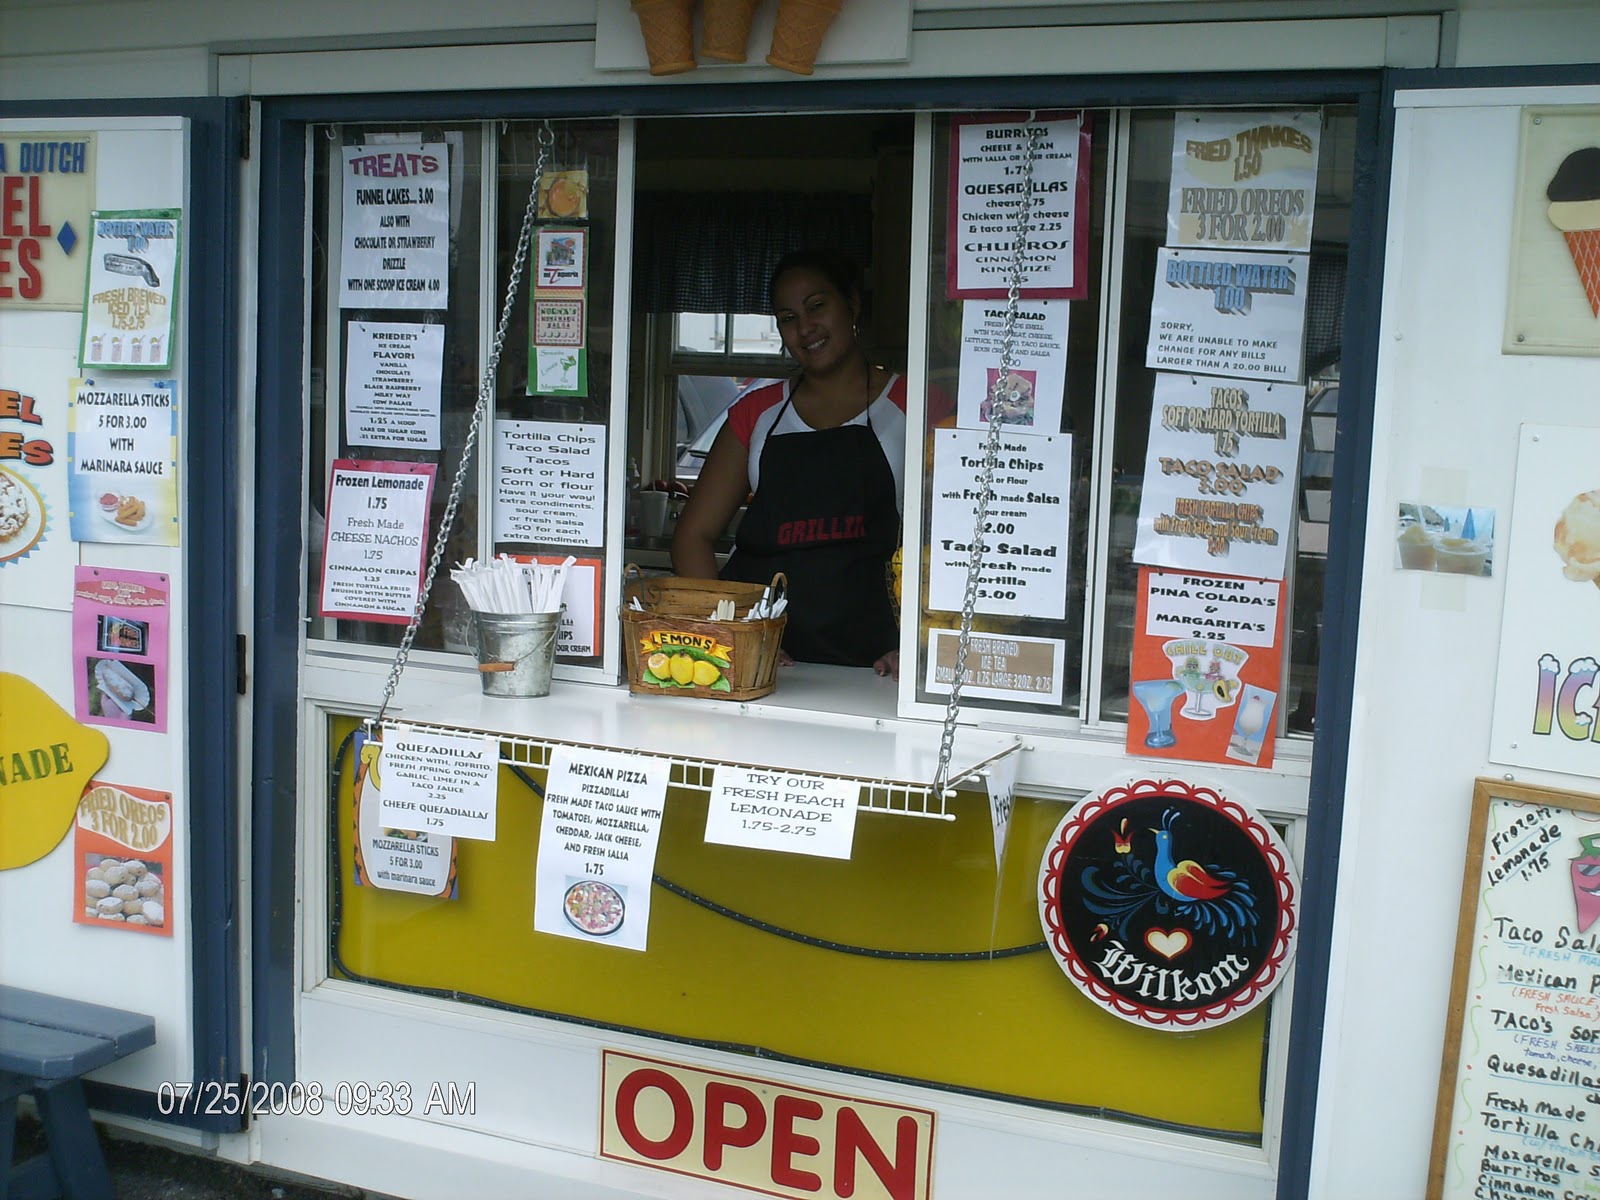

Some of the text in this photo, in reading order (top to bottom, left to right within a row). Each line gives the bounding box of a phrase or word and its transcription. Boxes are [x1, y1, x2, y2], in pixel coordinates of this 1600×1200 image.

[19, 141, 86, 173] DUTCH
[1186, 138, 1232, 162] FRIED
[349, 153, 439, 177] TREATS
[356, 189, 385, 205] FUNNEL
[418, 188, 434, 204] 3.00
[964, 181, 1068, 195] QUESADLLAS
[1181, 187, 1304, 216] FRIED OREOS
[380, 216, 410, 227] ALSO WITH
[1196, 213, 1286, 242] 3 FOR 2.00
[354, 238, 387, 249] CHOCOLATE
[397, 237, 436, 249] STRAWBERRY
[382, 258, 406, 270] DRIZZLE
[1166, 259, 1294, 293] BOTTLED WATER
[1214, 286, 1249, 312] 1.00
[1160, 321, 1194, 332] SORRY,
[372, 332, 418, 341] KRIEDER'S
[1159, 333, 1278, 349] WE ARE UNABLE TO MAKE
[373, 351, 415, 360] FLAVORS
[1158, 344, 1266, 360] CHANGE FOR ANY BILLS
[1156, 356, 1192, 366] LARGER
[1195, 359, 1220, 368] THAN
[1223, 361, 1230, 369] A
[1232, 363, 1260, 371] 20.00
[76, 392, 170, 408] MOZZARELLA STICKS
[1211, 387, 1247, 410] TACOS
[105, 415, 125, 428] FOR
[125, 416, 147, 429] 3.00
[1161, 405, 1285, 437] SOFT OR HARD TORTILLA
[109, 437, 134, 451] WITH
[501, 431, 596, 445] Tortilla Chips
[506, 443, 591, 455] Taco Salad
[80, 459, 163, 475] MARINARA SAUCE
[525, 455, 570, 466] Tacos
[1008, 458, 1044, 473] Chips
[501, 466, 534, 475] Soft
[560, 469, 595, 480] Hard
[1158, 457, 1284, 484] TACO SALAD
[335, 474, 424, 490] Frozen Lemonade
[501, 477, 534, 487] Corn
[560, 481, 594, 491] flour
[367, 497, 388, 510] 1.75
[1026, 491, 1060, 504] Salsa
[347, 517, 404, 530] Fresh Made
[984, 522, 1015, 535] 2.00
[330, 532, 419, 547] CHEESE NACHOS
[997, 543, 1058, 557] Salad
[328, 564, 417, 577] CINNAMON CRIPAS
[1183, 577, 1245, 590] FROZEN
[1150, 587, 1276, 607] PINA COLADA'S
[1204, 605, 1218, 614] &
[1155, 613, 1266, 632] MARGARITA'S
[651, 633, 713, 650] LEMONS
[1192, 630, 1225, 641] 2.25
[1166, 642, 1243, 666] CHILL OUT
[385, 752, 423, 763] CHICKEN
[396, 742, 483, 760] QUESADILLAS
[568, 762, 648, 786] MEXICAN PIZZA
[747, 773, 825, 790] TRY OUR
[581, 783, 630, 800] PIZZADILLAS
[722, 786, 845, 808] FRESH PEACH
[80, 787, 166, 826] FRIED OREOS
[382, 799, 489, 820] CHEESE QUESADIALLAS
[546, 793, 661, 820] FRESH MADE TACO SAUCE WITH
[730, 802, 832, 822] LEMONADE
[101, 811, 130, 845] FOR
[131, 822, 159, 849] 2.00
[426, 817, 444, 827] 1.75
[742, 819, 817, 837] 1.75-2.75
[1492, 807, 1551, 855] Frozen
[372, 838, 439, 857] MOZZARELLA STICKS
[1488, 825, 1562, 887] Lemonade
[585, 862, 605, 876] 1.75
[1493, 917, 1543, 944] Taco
[1498, 964, 1577, 990] Mexican
[1485, 1092, 1529, 1113] Fresh
[615, 1067, 919, 1200] OPEN
[1480, 1112, 1559, 1140] Tortilla
[1484, 1145, 1580, 1174] Mozarella
